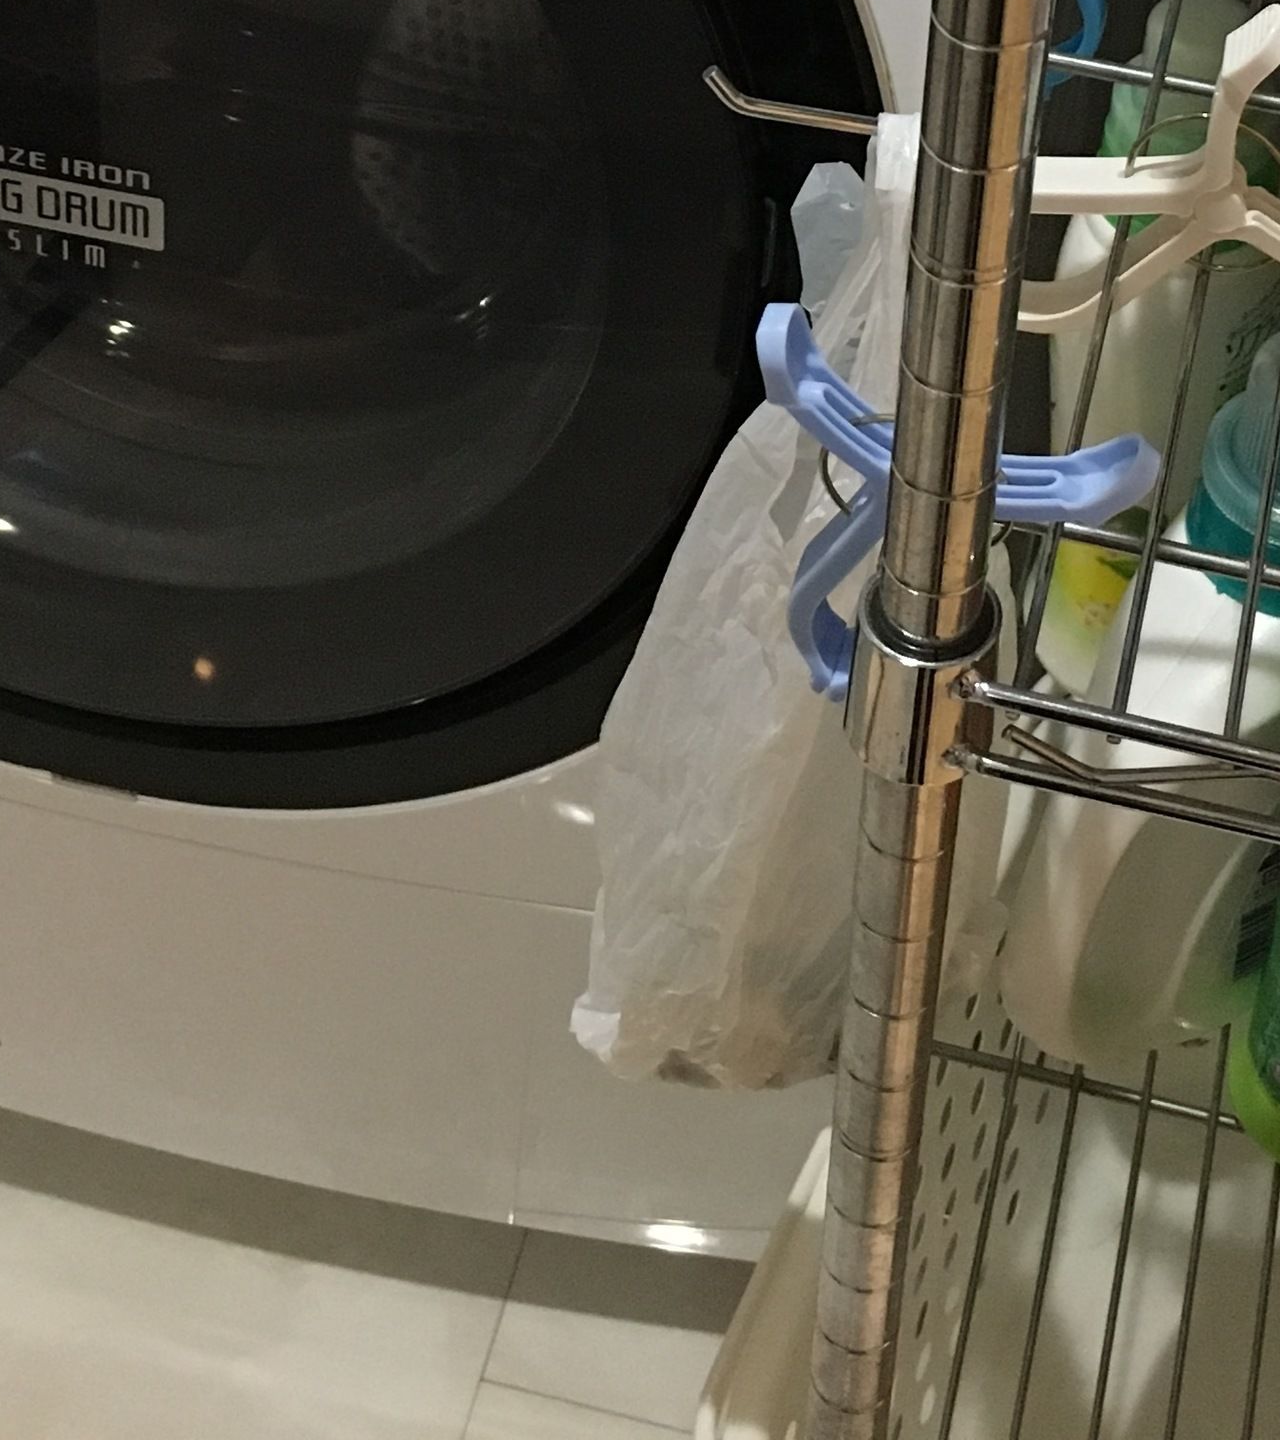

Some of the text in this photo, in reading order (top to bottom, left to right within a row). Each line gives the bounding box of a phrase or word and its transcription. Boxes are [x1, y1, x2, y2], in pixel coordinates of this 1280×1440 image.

[61, 156, 150, 191] IRON
[36, 185, 150, 238] DRUM
[8, 229, 106, 268] SLIM
